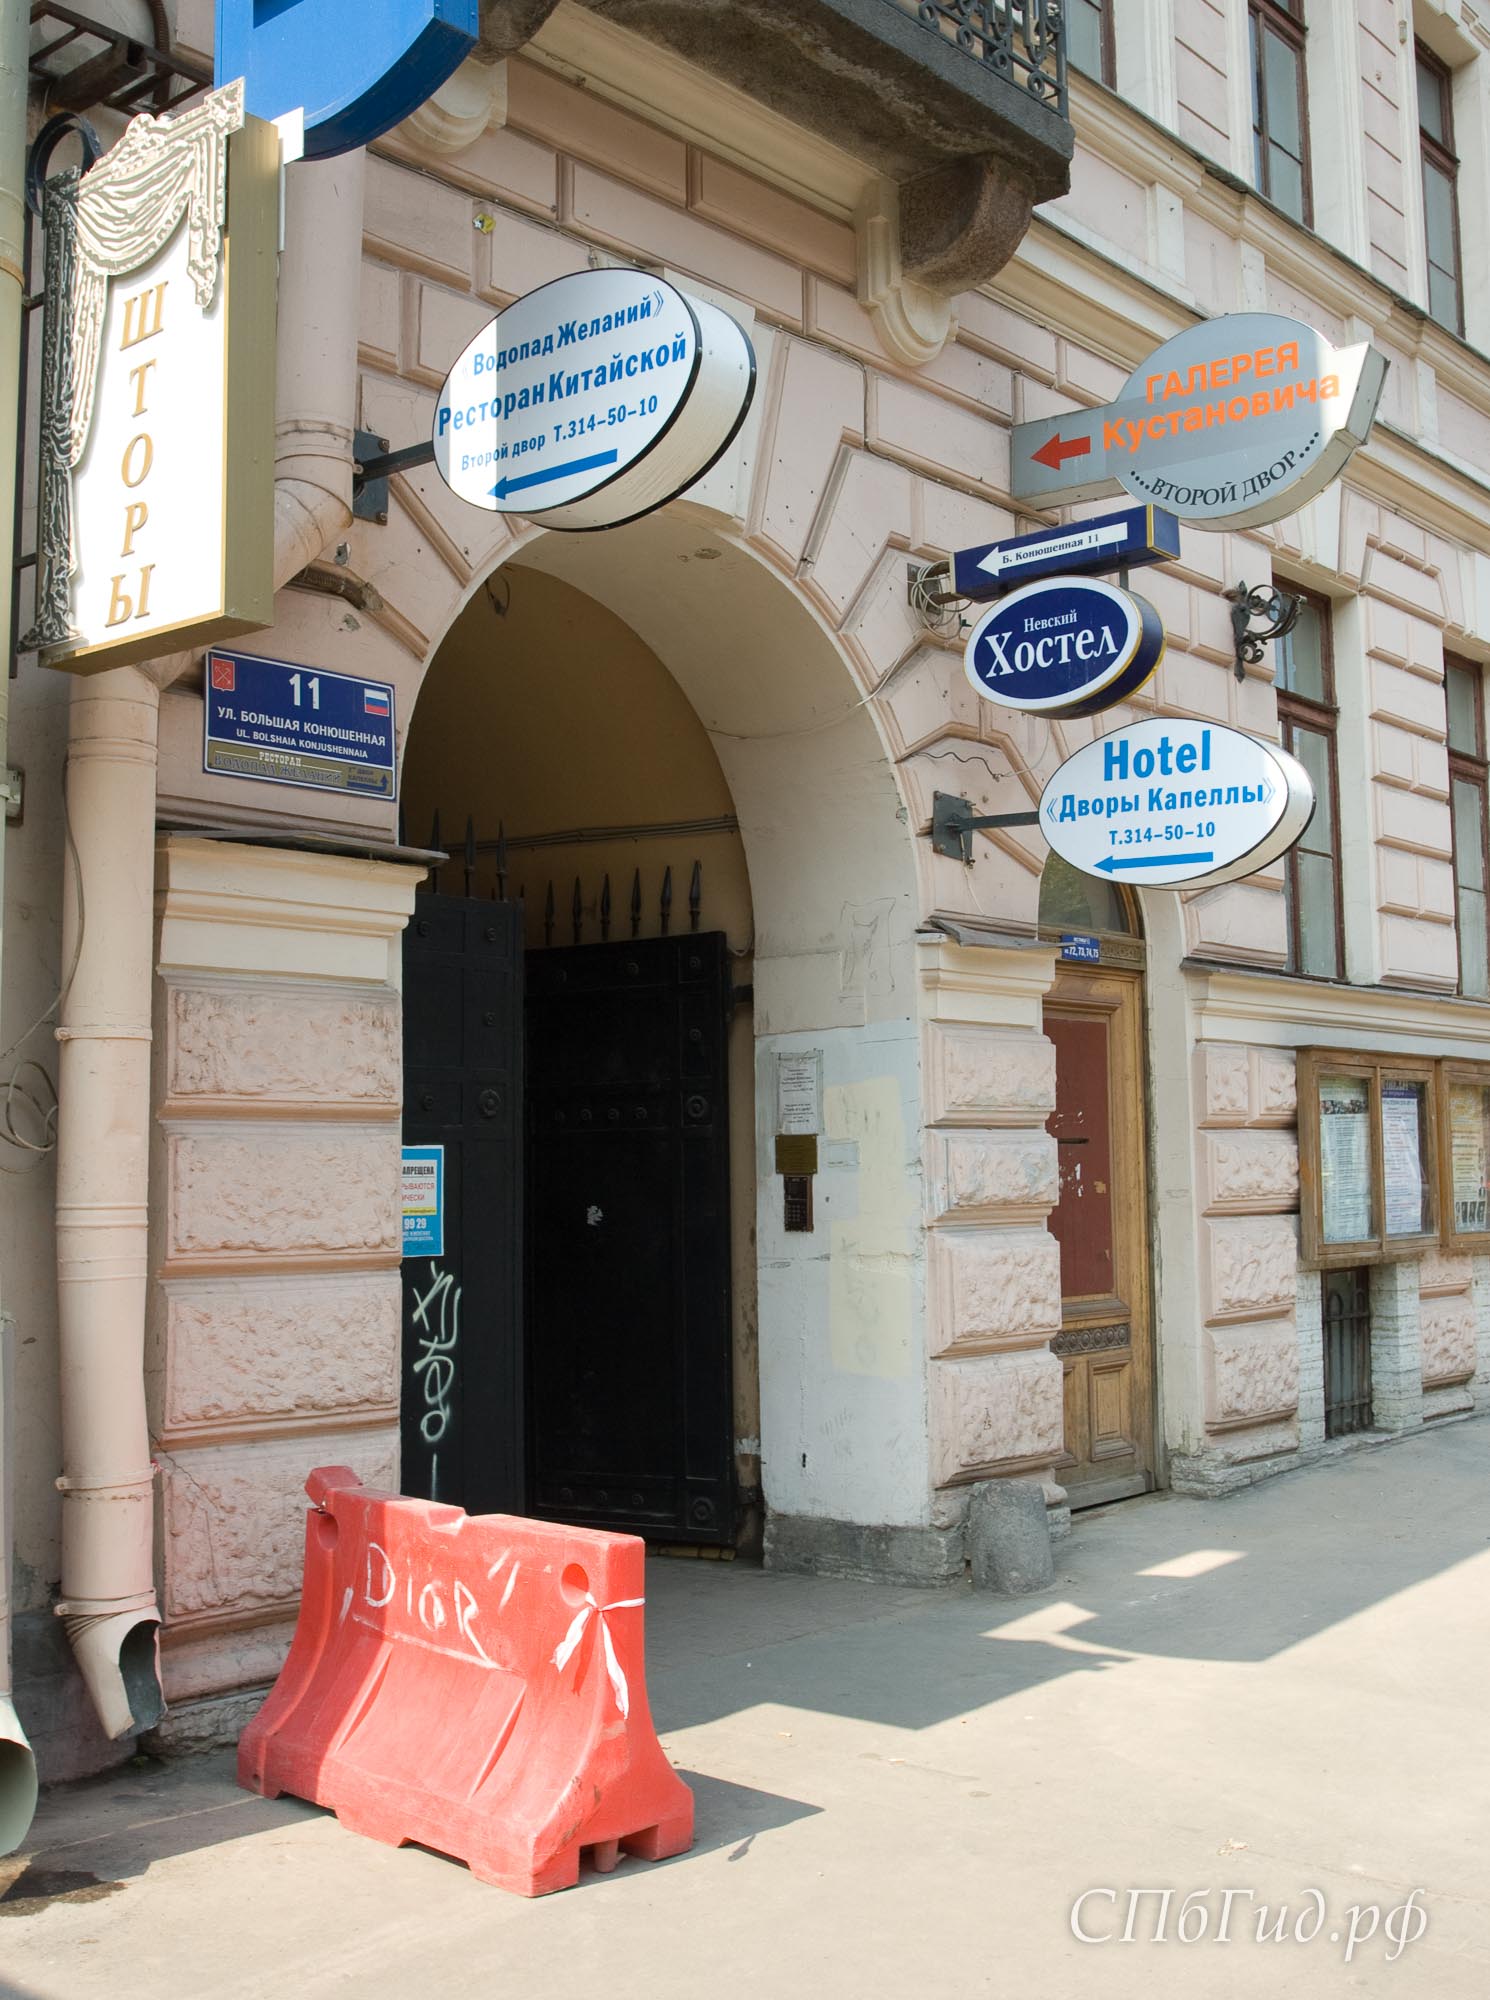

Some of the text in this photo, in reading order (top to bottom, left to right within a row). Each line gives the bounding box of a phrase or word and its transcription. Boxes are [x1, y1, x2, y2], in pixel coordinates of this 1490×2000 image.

[439, 334, 687, 437] Ресторан Китайской
[1146, 341, 1299, 404] ГАЛЕРЕЯ
[1103, 373, 1340, 454] Кустановича
[104, 280, 169, 628] ШТОРЫ
[461, 443, 508, 471] Второй
[512, 434, 545, 458] двор
[1002, 534, 1099, 563] Б. Конюшенная 11
[1024, 610, 1077, 633] Невский
[985, 625, 1118, 678] Хостел
[289, 673, 319, 710] 11
[218, 707, 385, 746] УЛ. БОЛЬШАЯ КОНЮШЕННАЯ
[236, 729, 367, 758] UL. BOLSHAIA KONJUSHENNAIA
[1104, 730, 1211, 781] Hotel
[402, 1166, 434, 1175] АПРЕЩЕНА
[404, 1218, 427, 1230] 99 29
